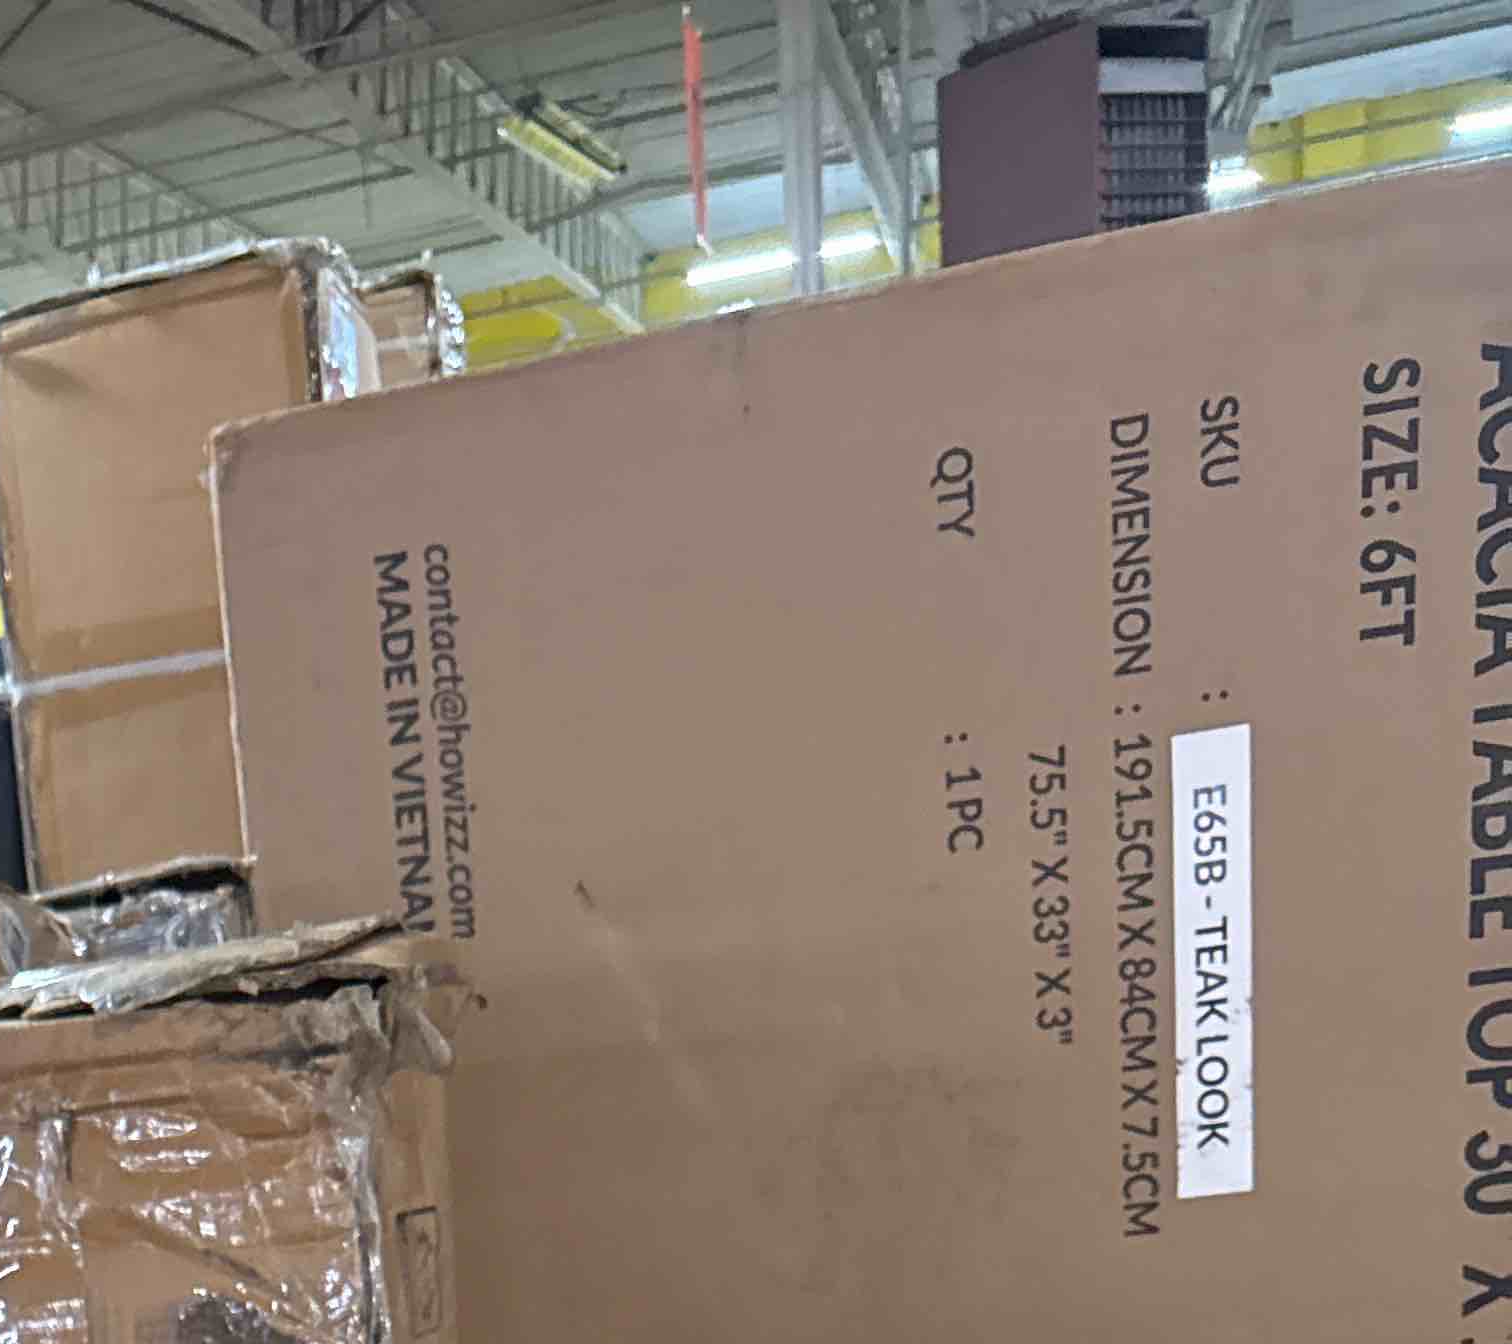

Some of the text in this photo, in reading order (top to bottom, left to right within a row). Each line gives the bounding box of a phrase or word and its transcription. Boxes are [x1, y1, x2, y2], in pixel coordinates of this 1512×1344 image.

[929, 446, 975, 538] QTY
[1199, 395, 1241, 488] SKU
[1109, 413, 1153, 677] DIMENSION
[1359, 357, 1422, 647] SIZE: 6FT
[373, 551, 435, 934] MADE IN VIETNA
[424, 544, 476, 939] contact@howizz.com
[1031, 856, 1069, 888] X
[1113, 734, 1154, 912] 191.5CM
[1192, 784, 1228, 887] E65B
[1035, 968, 1071, 998] X
[1117, 920, 1156, 951] X
[1194, 916, 1229, 1026] TEAK
[1119, 957, 1157, 1072] 84CM
[1121, 1080, 1159, 1111] X
[1196, 1036, 1230, 1150] LOOK
[1122, 1117, 1161, 1239] 7.5CM
